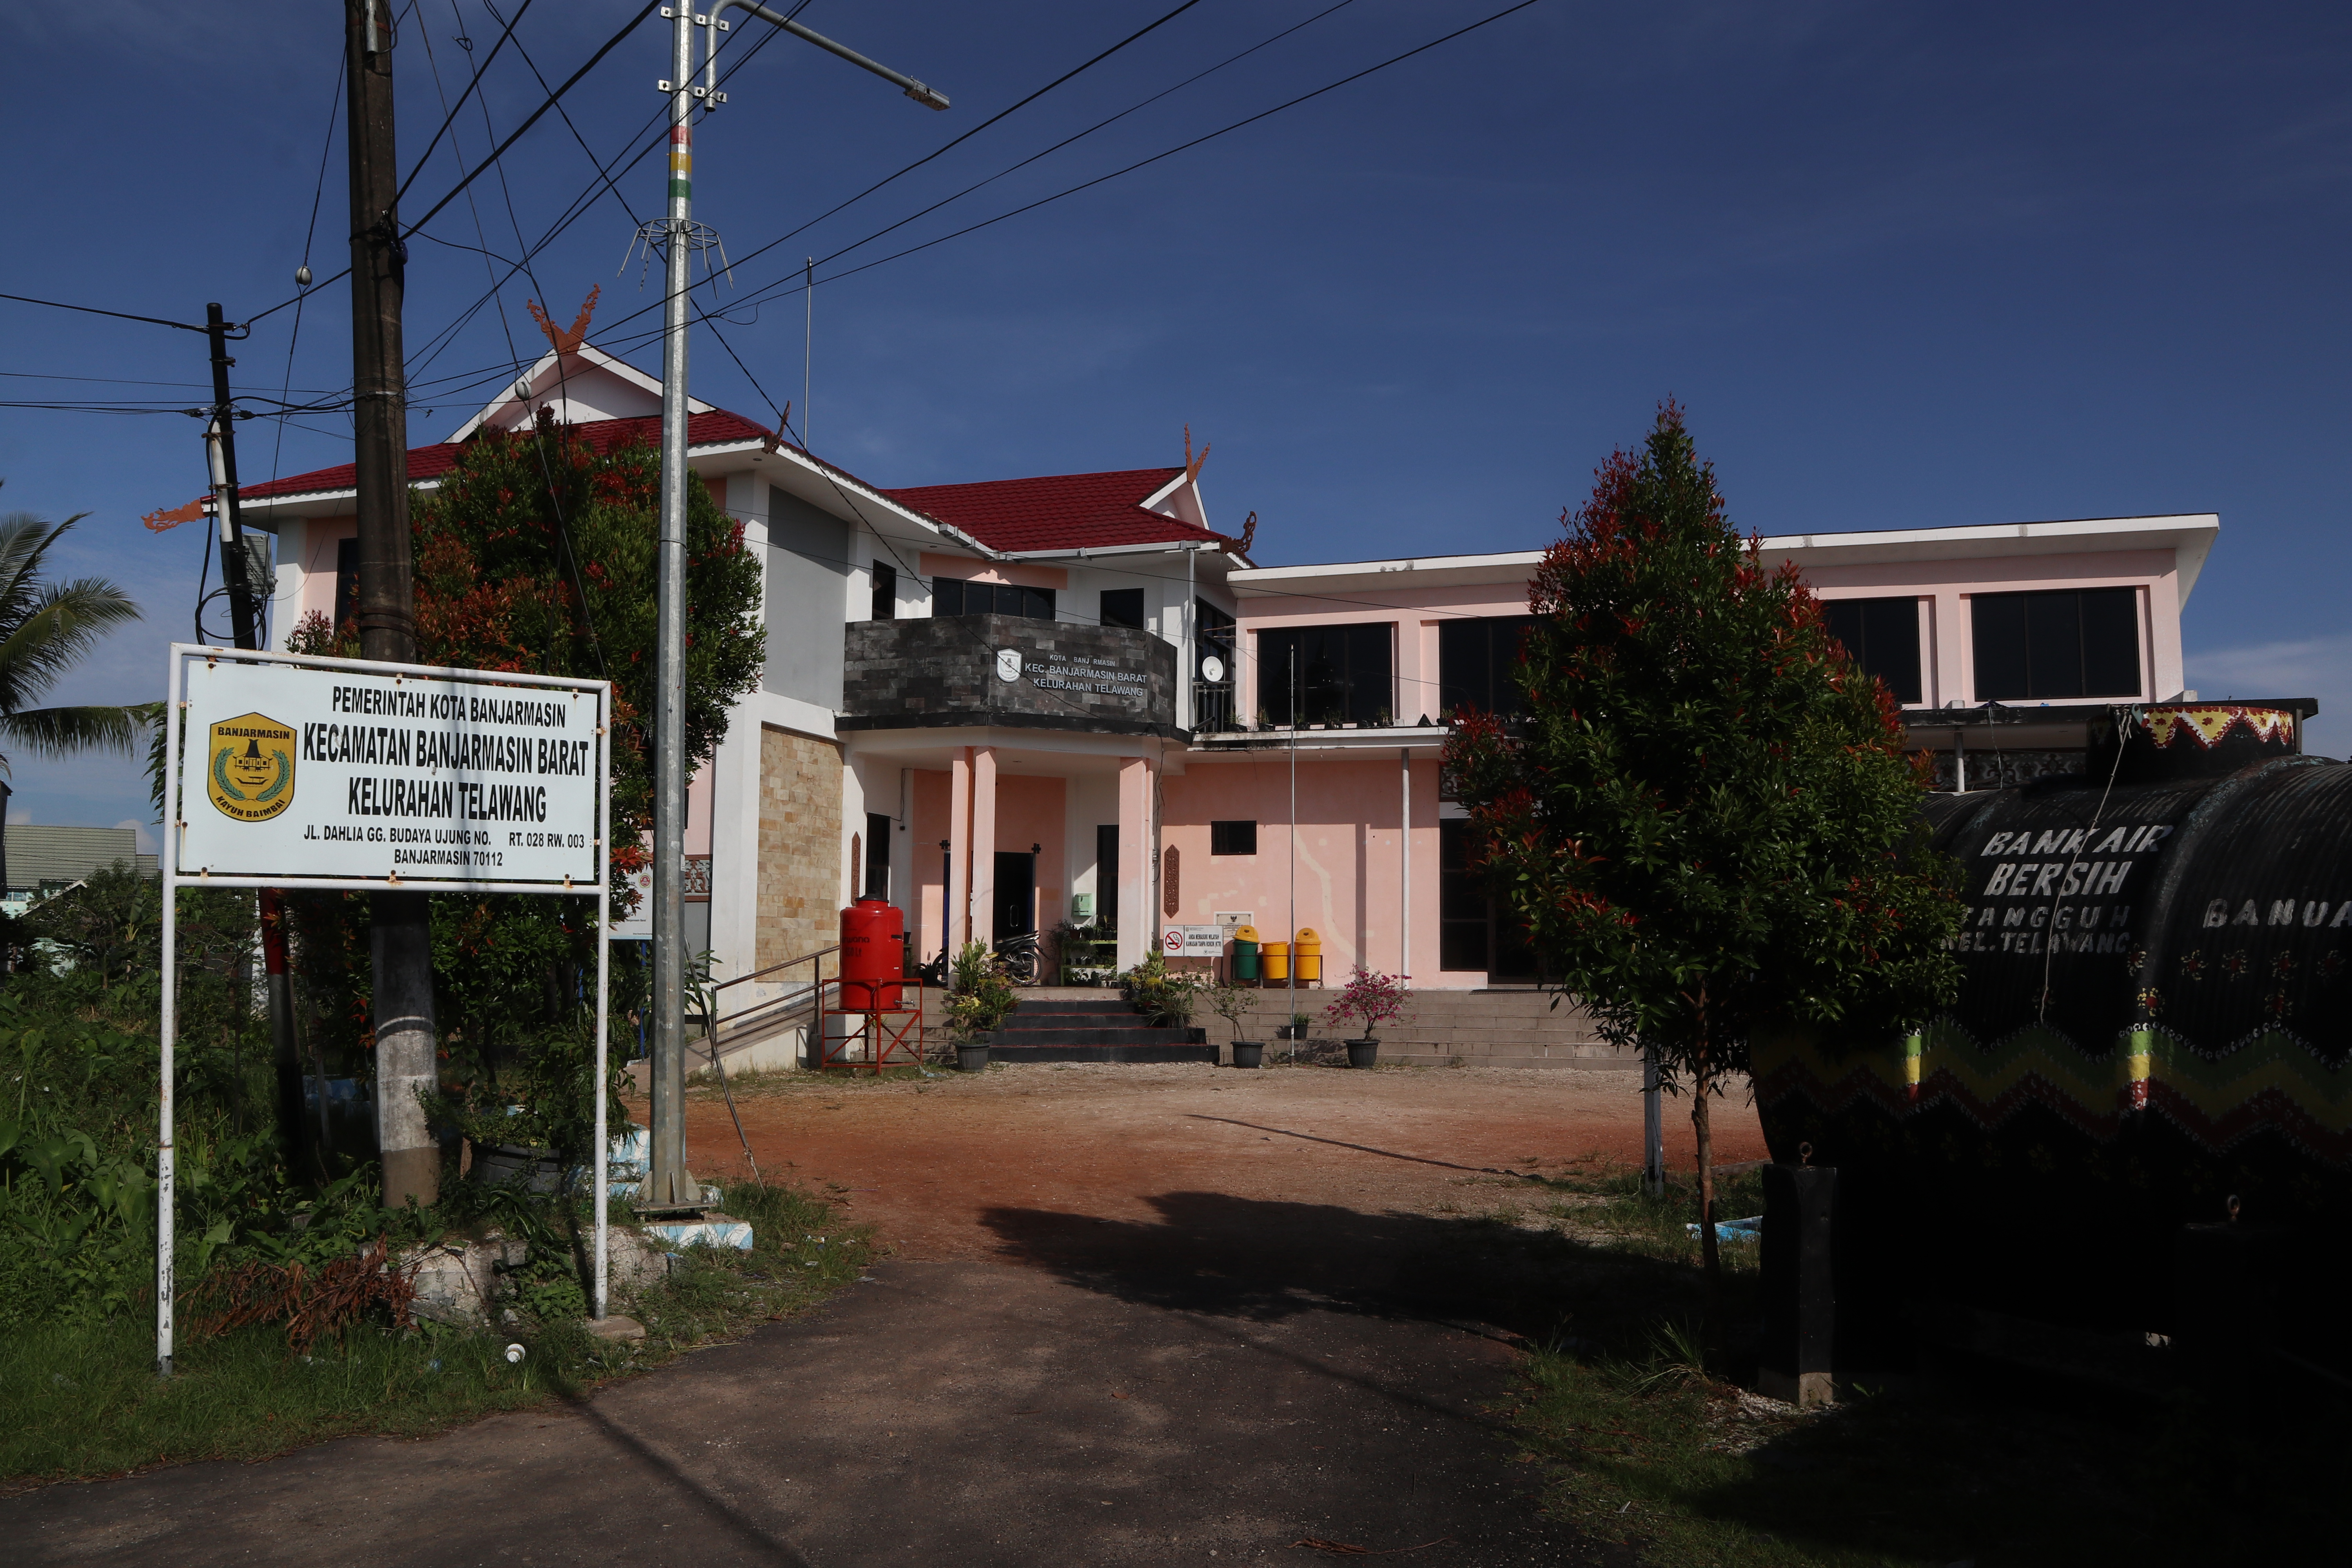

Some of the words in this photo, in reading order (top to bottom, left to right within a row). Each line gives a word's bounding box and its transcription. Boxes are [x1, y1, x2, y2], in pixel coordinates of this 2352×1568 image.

[1025, 663, 1047, 673] KEC.
[1049, 665, 1114, 681] BANJARMASIN
[1117, 672, 1147, 683] BARAT
[1033, 678, 1091, 692] KELURAHAN
[1095, 684, 1143, 697] TELAWANG
[332, 686, 425, 718] PEMERINTAH
[430, 694, 466, 721] KOTA
[470, 697, 566, 728] BANJARMASIN
[218, 727, 290, 739] BANJARMASIN
[303, 722, 410, 766] KECAMATAN
[416, 730, 532, 773] BANJARMASIN
[538, 739, 588, 776] BARAT
[216, 796, 244, 816] KAYUH
[246, 799, 285, 817] BAIMBAI
[348, 777, 453, 818] KELURAHAN
[459, 782, 546, 822] TELAWANG
[304, 825, 320, 840] JL.
[324, 825, 363, 841] DAHLIA
[367, 827, 386, 842] GG.
[390, 828, 432, 843] BUDAYA
[435, 829, 471, 845] UJUNG
[474, 831, 491, 846] NO.
[509, 832, 523, 846] RT.
[527, 833, 544, 847] 028
[547, 833, 564, 848] RW.
[568, 834, 584, 848] 003
[1980, 828, 2100, 856] BANK
[2092, 825, 2174, 853] AIR
[394, 849, 470, 865] BANJARMASIN
[474, 851, 503, 866] 70112
[1983, 861, 2132, 897] BERSIH
[1961, 906, 2129, 929] TANGGUH
[2203, 898, 2352, 928] BANUA
